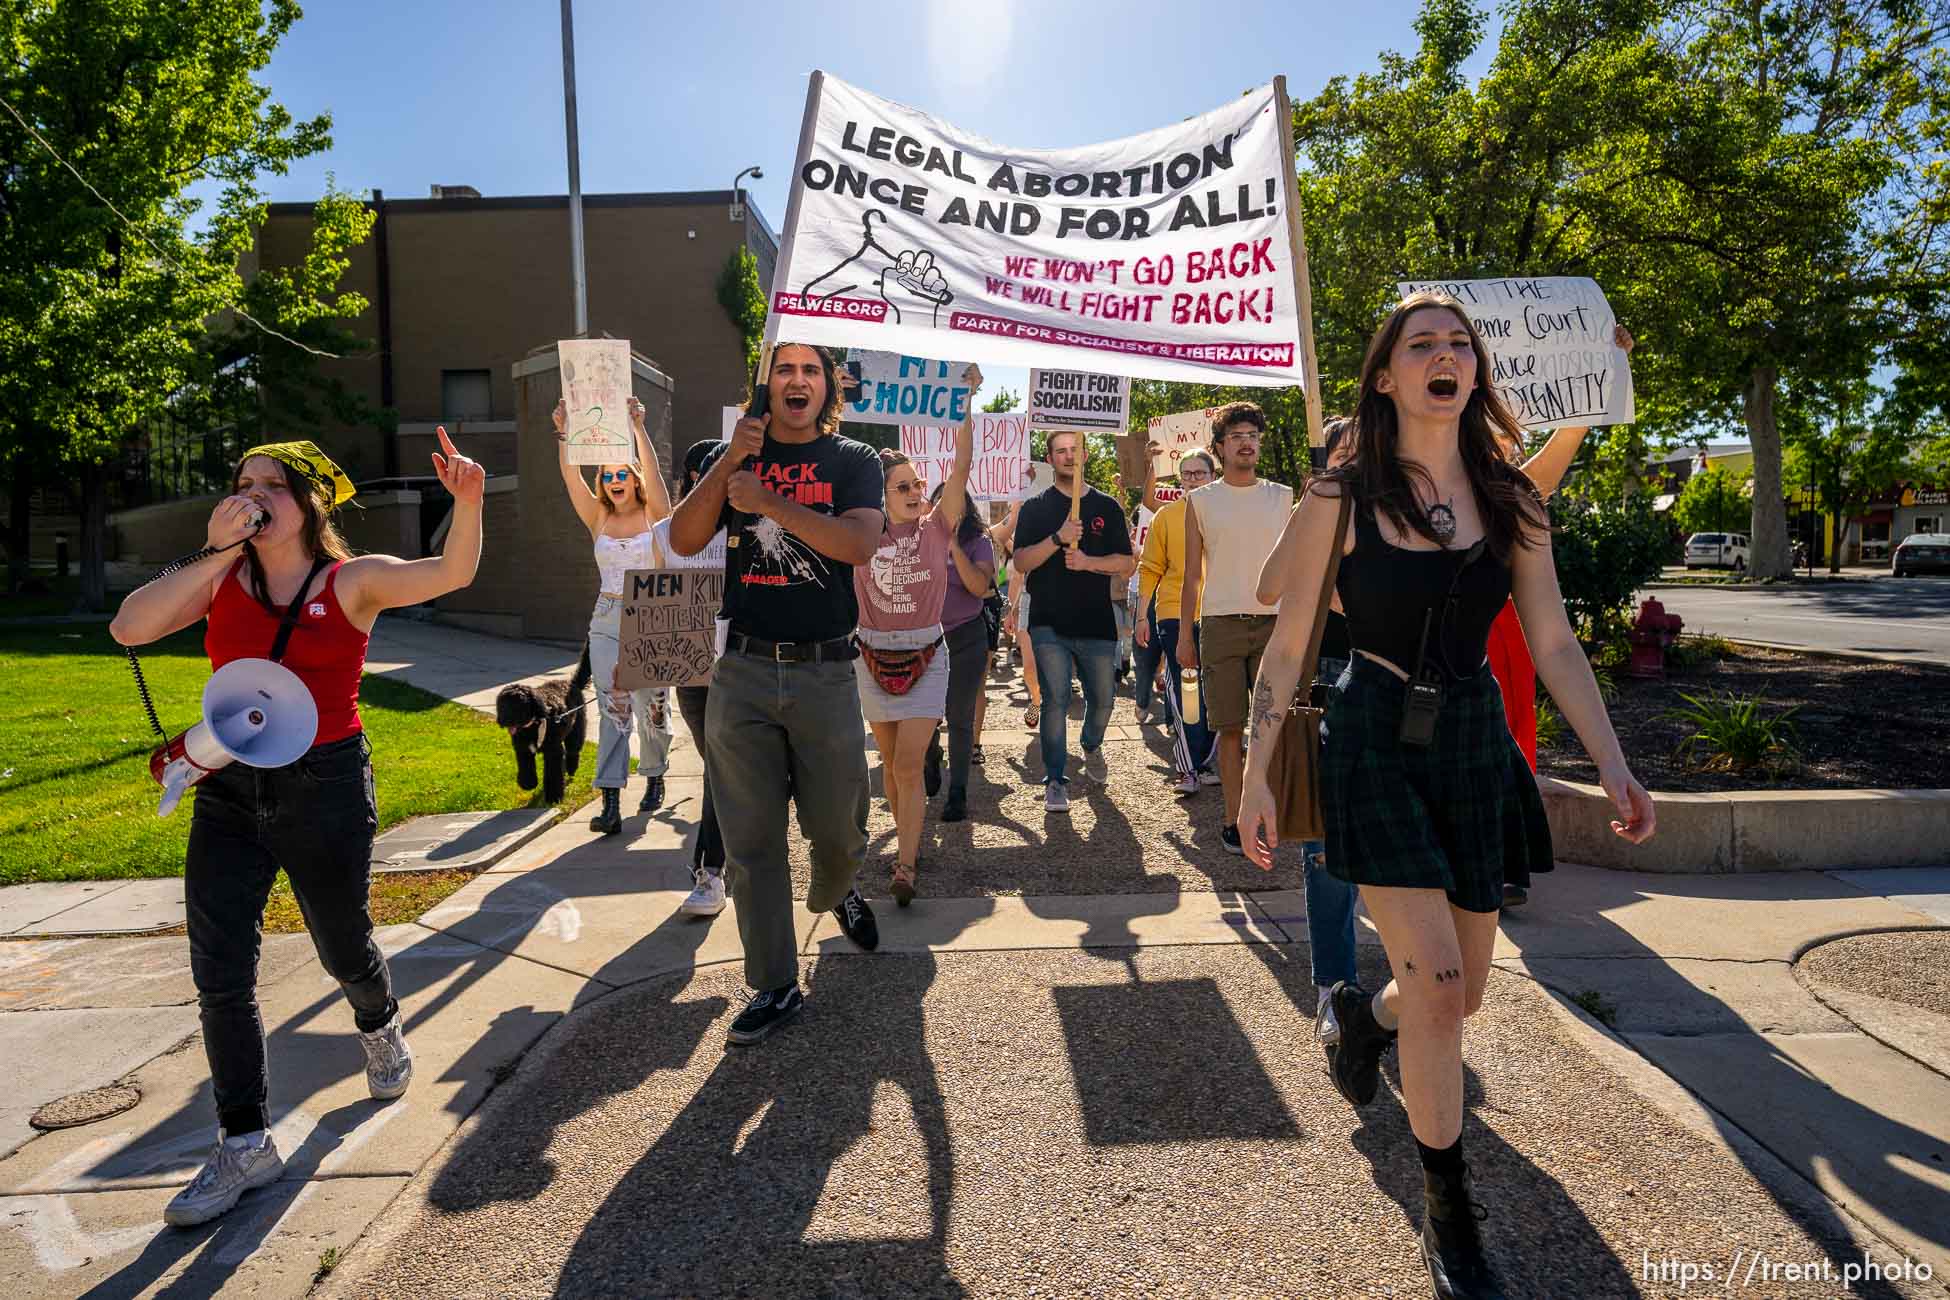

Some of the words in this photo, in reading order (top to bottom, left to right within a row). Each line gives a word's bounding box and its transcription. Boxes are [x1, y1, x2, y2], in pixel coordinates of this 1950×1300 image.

[841, 121, 976, 184] LEGAL
[987, 134, 1234, 197] ABORTION
[802, 159, 929, 216] ONCE
[938, 196, 1041, 236] AND
[1056, 207, 1151, 240] FOR
[1168, 178, 1277, 231] ALL!
[1004, 255, 1034, 279] WE
[1043, 258, 1124, 284] WON'T
[1133, 254, 1174, 285] GO
[1186, 237, 1276, 283] BACK
[985, 275, 1012, 298] WE
[1021, 285, 1072, 311] WILL
[1080, 291, 1162, 322] FIGHT
[1171, 287, 1274, 325] BACK!
[1488, 280, 1551, 299] THE
[778, 296, 885, 317] PSLWEB.ORG
[1524, 305, 1589, 340] Court
[957, 315, 1010, 332] PARTY
[1016, 323, 1050, 338] FOR
[1056, 331, 1152, 354] SOCIALISM
[1158, 345, 1169, 356] &
[1175, 345, 1292, 363] LIBERATION
[1040, 371, 1085, 391] FIGHT
[1087, 375, 1119, 393] FOR
[1033, 391, 1122, 413] SOCIALISM!
[1503, 369, 1606, 421] DIGNITY
[1149, 417, 1163, 428] MY
[984, 419, 1027, 454] BODY
[1177, 432, 1198, 443] MY
[753, 462, 817, 482] LACK
[979, 455, 1028, 494] CHOICE
[633, 573, 683, 601] MEN
[893, 570, 931, 585] DECISIONS
[893, 593, 911, 602] BEING
[893, 602, 917, 614] MADE
